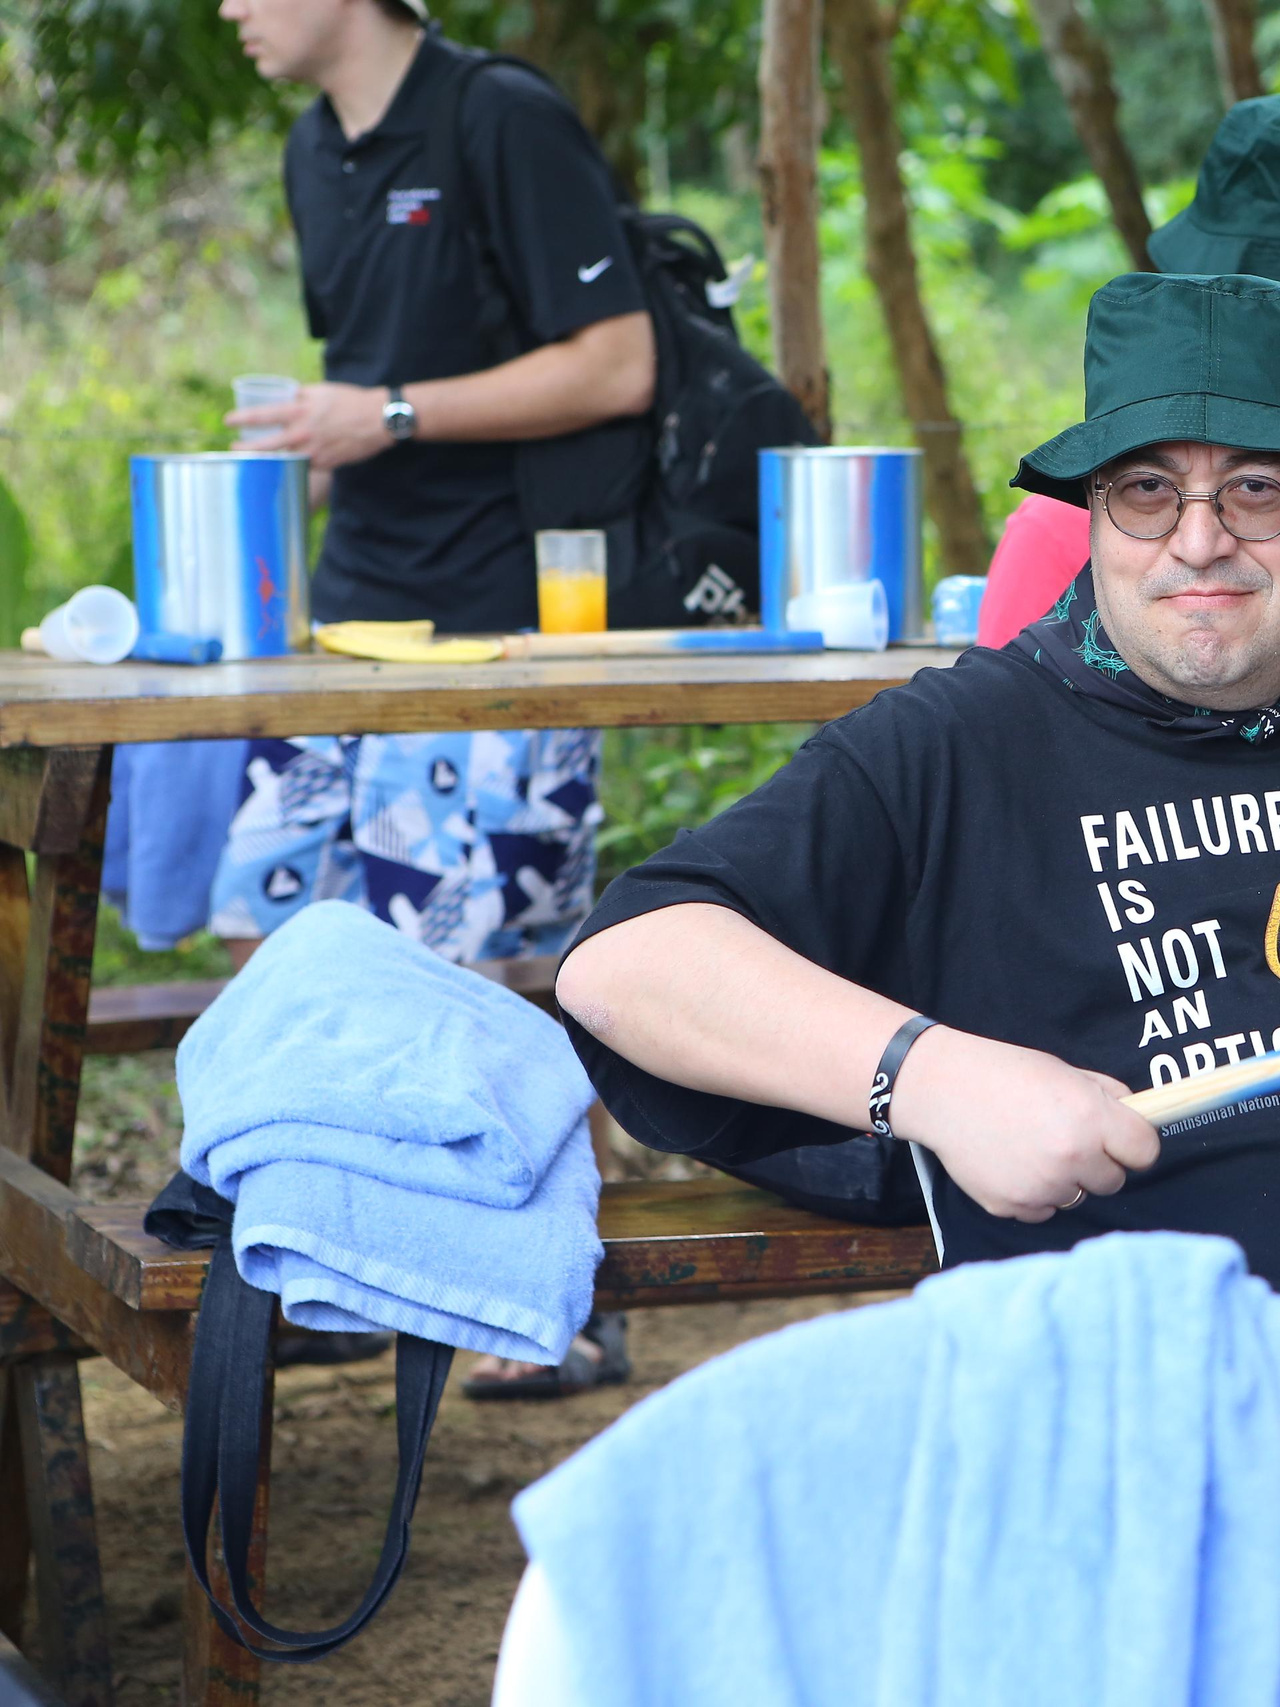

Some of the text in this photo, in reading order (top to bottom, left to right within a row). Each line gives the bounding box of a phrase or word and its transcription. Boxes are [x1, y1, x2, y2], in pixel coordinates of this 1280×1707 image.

[1097, 879, 1155, 932] IS
[1117, 919, 1227, 1002] NOT
[1138, 991, 1211, 1048] AN
[1161, 1105, 1235, 1137] Smithsonian
